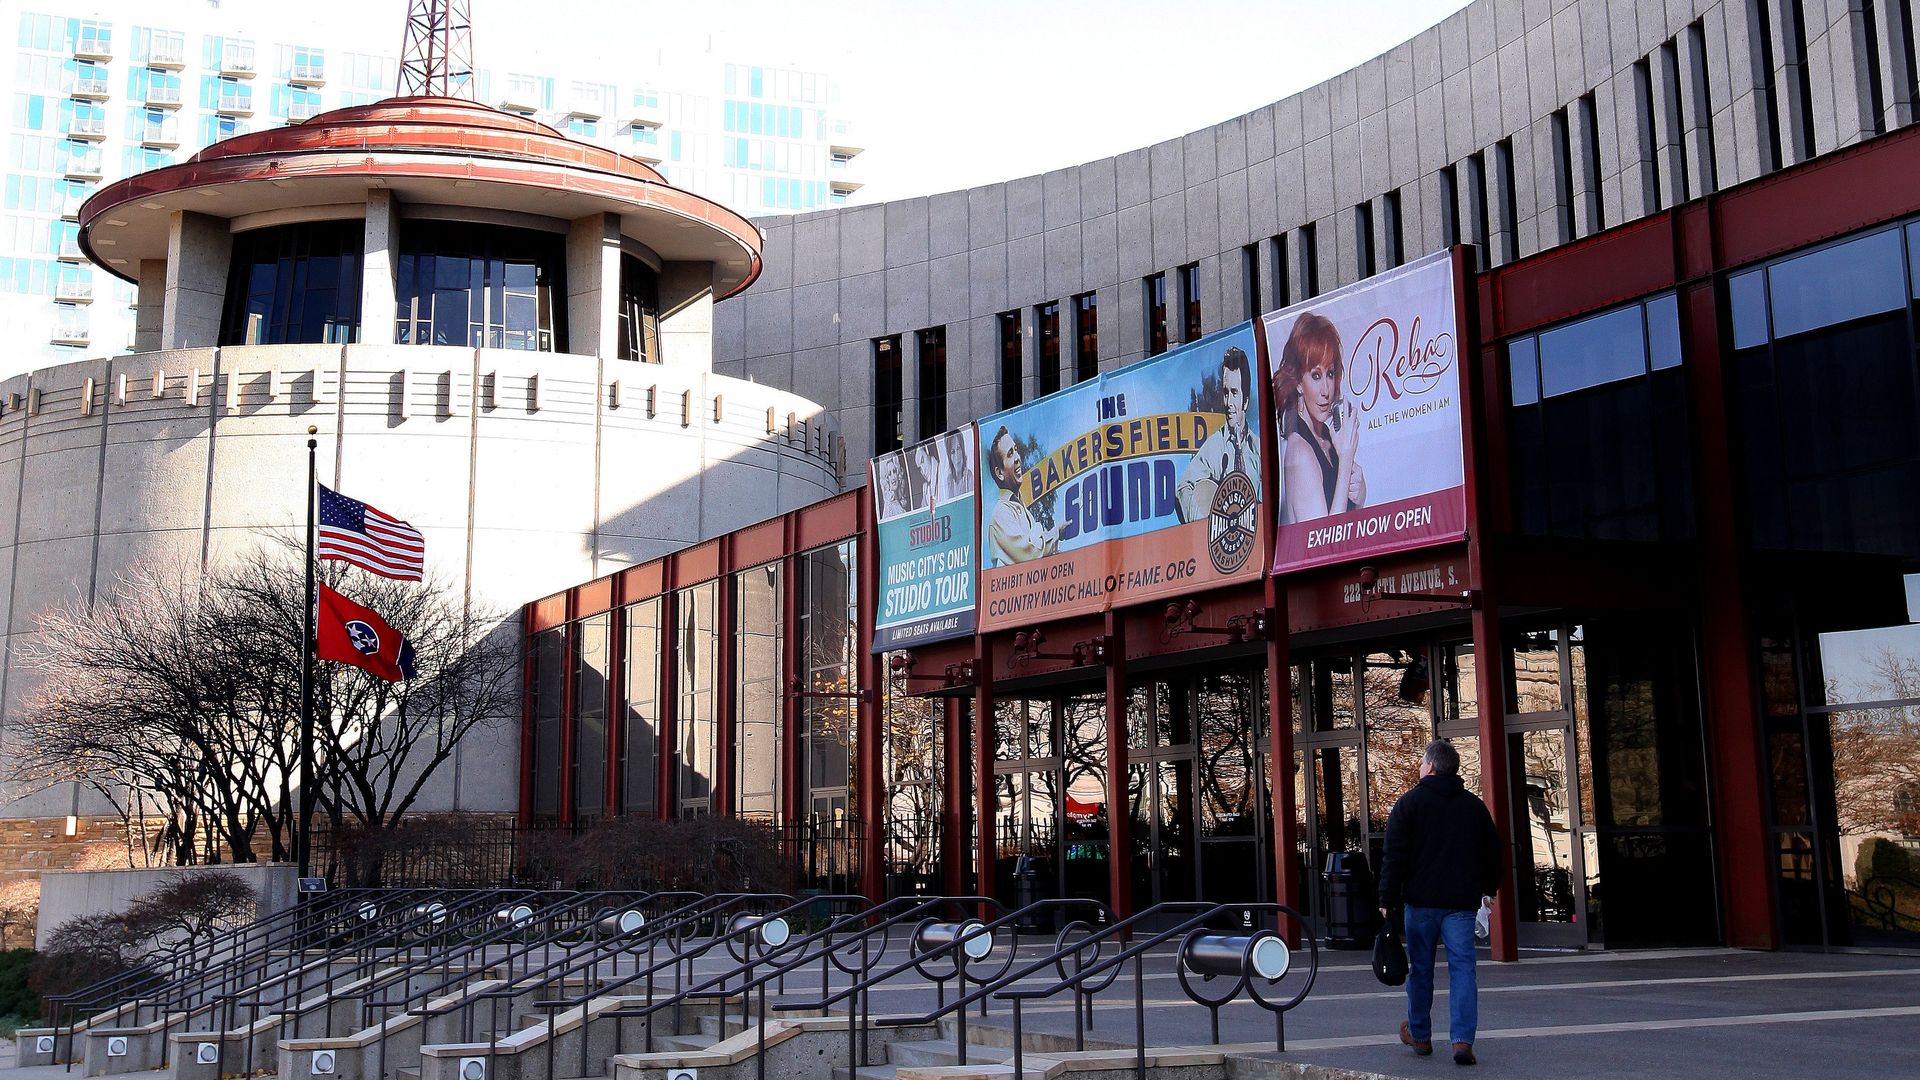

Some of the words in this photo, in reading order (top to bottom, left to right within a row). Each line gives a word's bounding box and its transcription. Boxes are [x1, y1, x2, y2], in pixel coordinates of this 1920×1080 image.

[1348, 316, 1453, 412] Reba
[1096, 393, 1127, 422] THE
[1368, 417, 1382, 430] ALL
[1384, 411, 1399, 425] THE
[1401, 402, 1432, 419] WOMEN
[1439, 397, 1450, 409] AM
[1030, 415, 1208, 500] BAKERSFIELD
[1064, 459, 1176, 541] SOUND
[1217, 478, 1254, 506] COUNTRY
[1223, 492, 1245, 513] MUSIC
[910, 521, 940, 546] STUDIO
[941, 515, 952, 543] B
[1211, 513, 1228, 543] HALL
[1230, 518, 1237, 527] OF
[1238, 502, 1255, 531] FAME
[1307, 522, 1353, 549] EXHIBIT
[1356, 514, 1391, 538] NOW
[1394, 505, 1431, 531] OPEN
[1213, 538, 1251, 566] NASHVILLE
[1221, 533, 1244, 552] MUSEUM
[888, 560, 916, 586] MUSIC
[917, 552, 945, 578] CITY'S
[947, 545, 970, 570] ONLY
[990, 573, 1024, 593] EXHIBIT
[1026, 567, 1048, 585] NOW
[1050, 561, 1074, 579] OPEN
[885, 580, 932, 618] STUDIO
[935, 571, 969, 607] TOUR
[1344, 583, 1360, 603] 222
[1448, 565, 1458, 586] S.
[892, 627, 913, 640] LIMITED
[913, 623, 929, 636] SEATS
[929, 617, 959, 633] AVAILABLE
